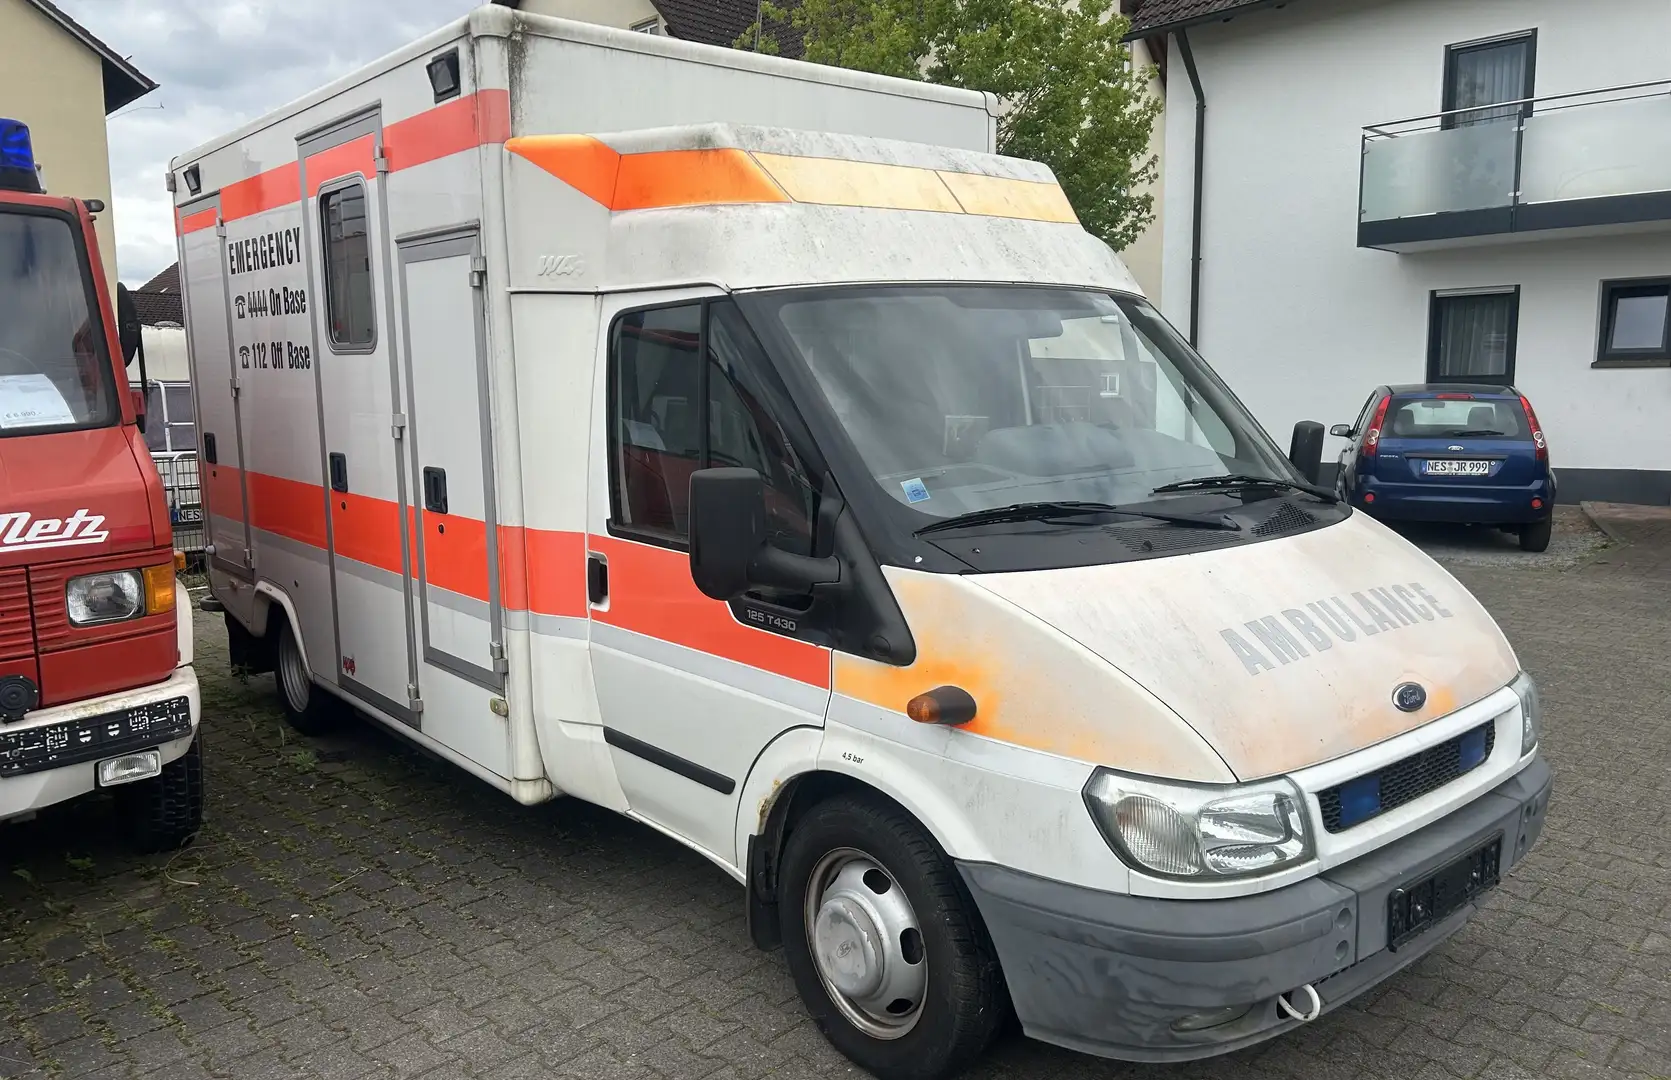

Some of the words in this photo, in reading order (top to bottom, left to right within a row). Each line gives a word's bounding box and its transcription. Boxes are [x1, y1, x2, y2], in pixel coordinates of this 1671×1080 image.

[229, 227, 300, 275] EMERGENCY
[247, 290, 268, 318] 4444
[269, 288, 282, 316] On
[283, 286, 306, 315] Base
[252, 342, 268, 369] 112
[270, 341, 284, 369] Off
[287, 341, 311, 369] Base
[1427, 461, 1447, 472] NES
[1453, 461, 1467, 472] JR
[1469, 461, 1488, 472] 999
[179, 510, 200, 521] NES
[746, 609, 765, 622] 125
[767, 614, 796, 632] T430
[1219, 582, 1454, 676] AMBULANCE
[852, 754, 864, 765] bar
